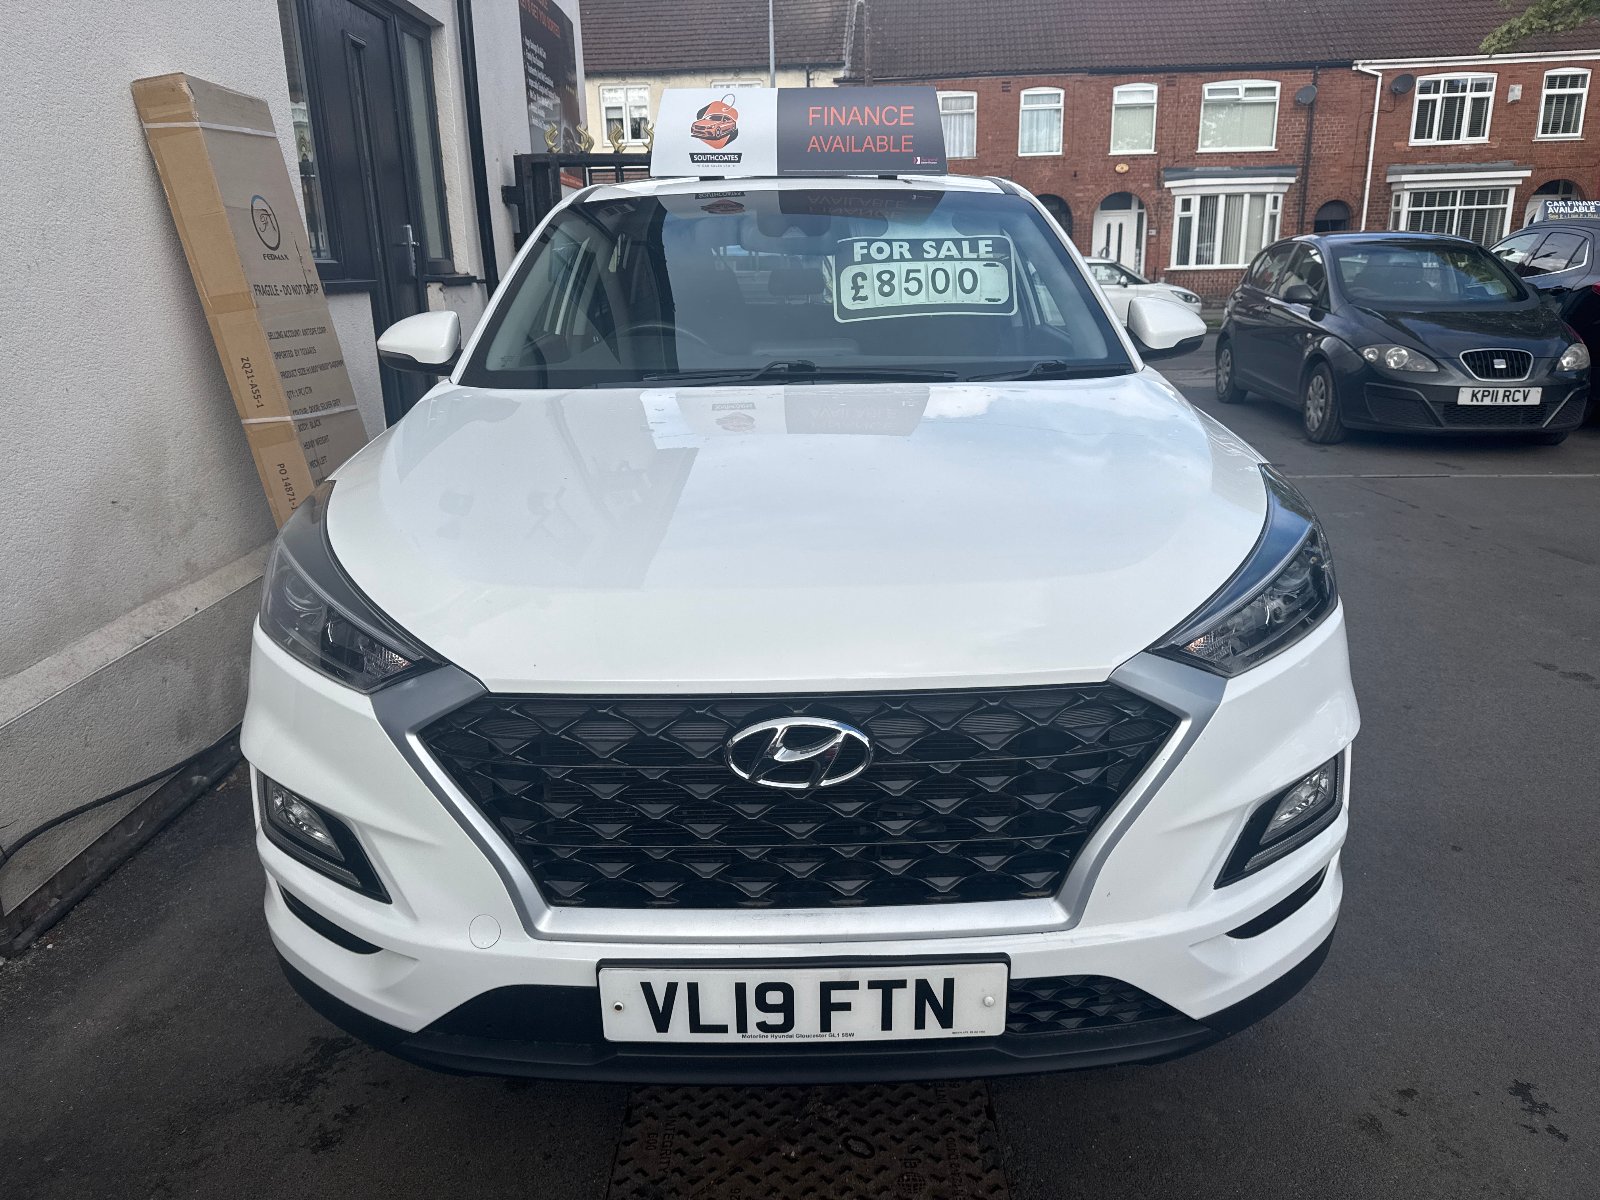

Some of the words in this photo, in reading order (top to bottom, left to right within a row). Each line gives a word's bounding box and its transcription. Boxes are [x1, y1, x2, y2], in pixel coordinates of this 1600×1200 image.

[808, 105, 915, 126] FINANCE
[807, 135, 914, 152] AVAILABLE
[853, 241, 912, 262] FOR
[922, 240, 994, 259] SALE
[253, 284, 280, 296] FRAGILE
[282, 284, 290, 296] DO
[291, 284, 302, 296] NOT
[851, 267, 978, 302] £8500
[267, 330, 283, 340] SELLING
[274, 350, 294, 360] IMPORTED
[280, 368, 297, 379] PRODUCT
[240, 356, 264, 408] ZQ21-A55-1
[1470, 390, 1500, 402] KP11
[1502, 390, 1530, 402] RCV
[277, 464, 288, 475] PO
[639, 981, 794, 1034] VL19
[819, 977, 955, 1032] FTN
